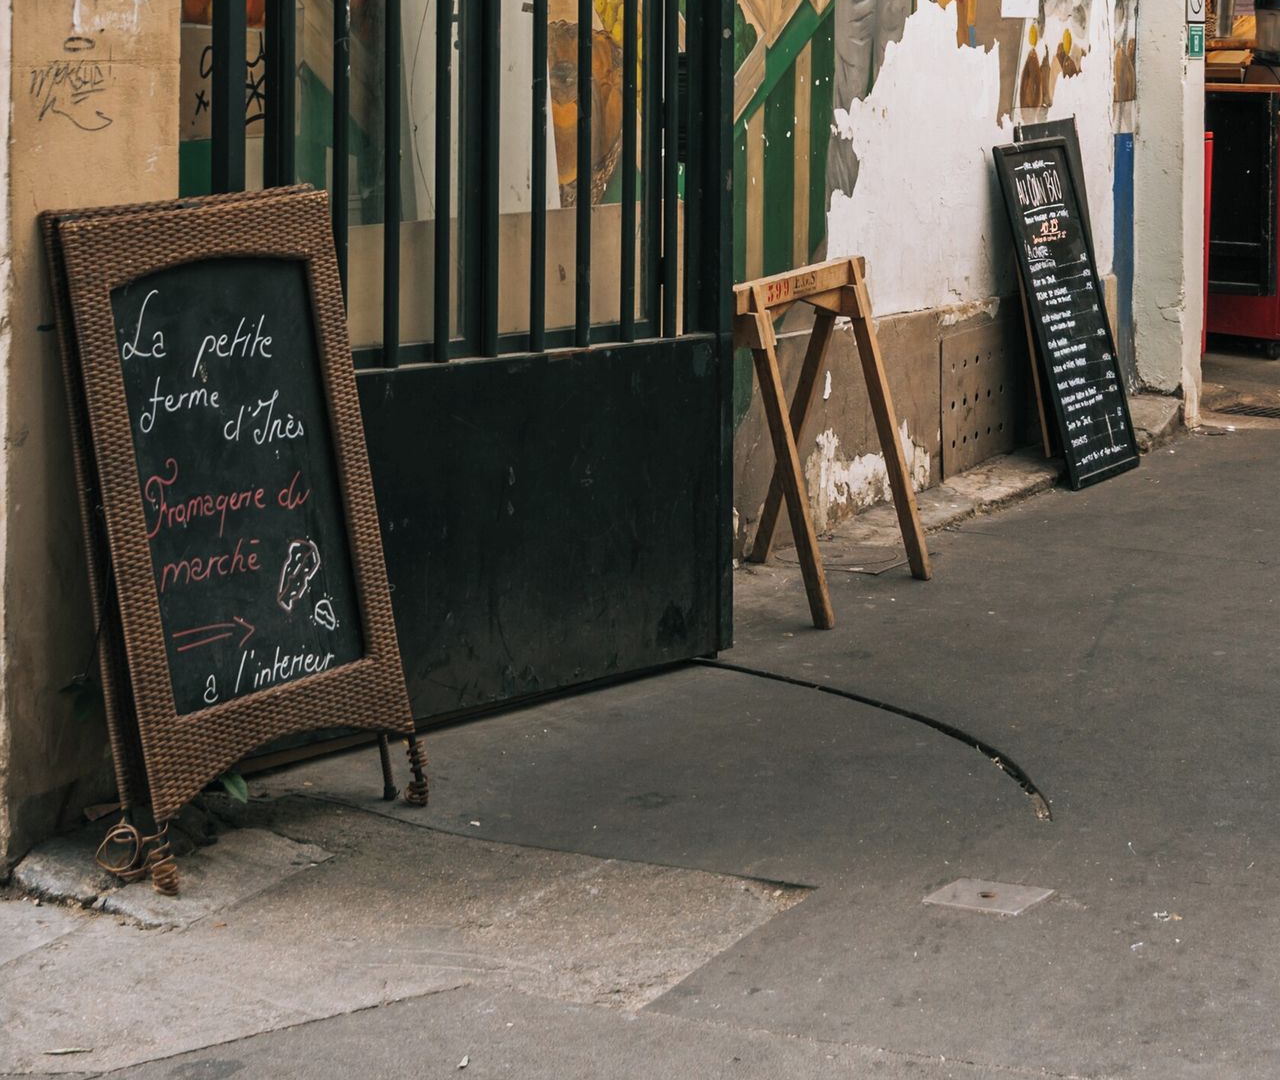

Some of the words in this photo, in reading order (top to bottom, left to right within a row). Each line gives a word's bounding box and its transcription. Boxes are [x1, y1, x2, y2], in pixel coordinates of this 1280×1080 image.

[122, 288, 167, 361] La
[192, 314, 274, 379] petite
[145, 457, 265, 540] Fromagerie
[278, 471, 310, 510] du
